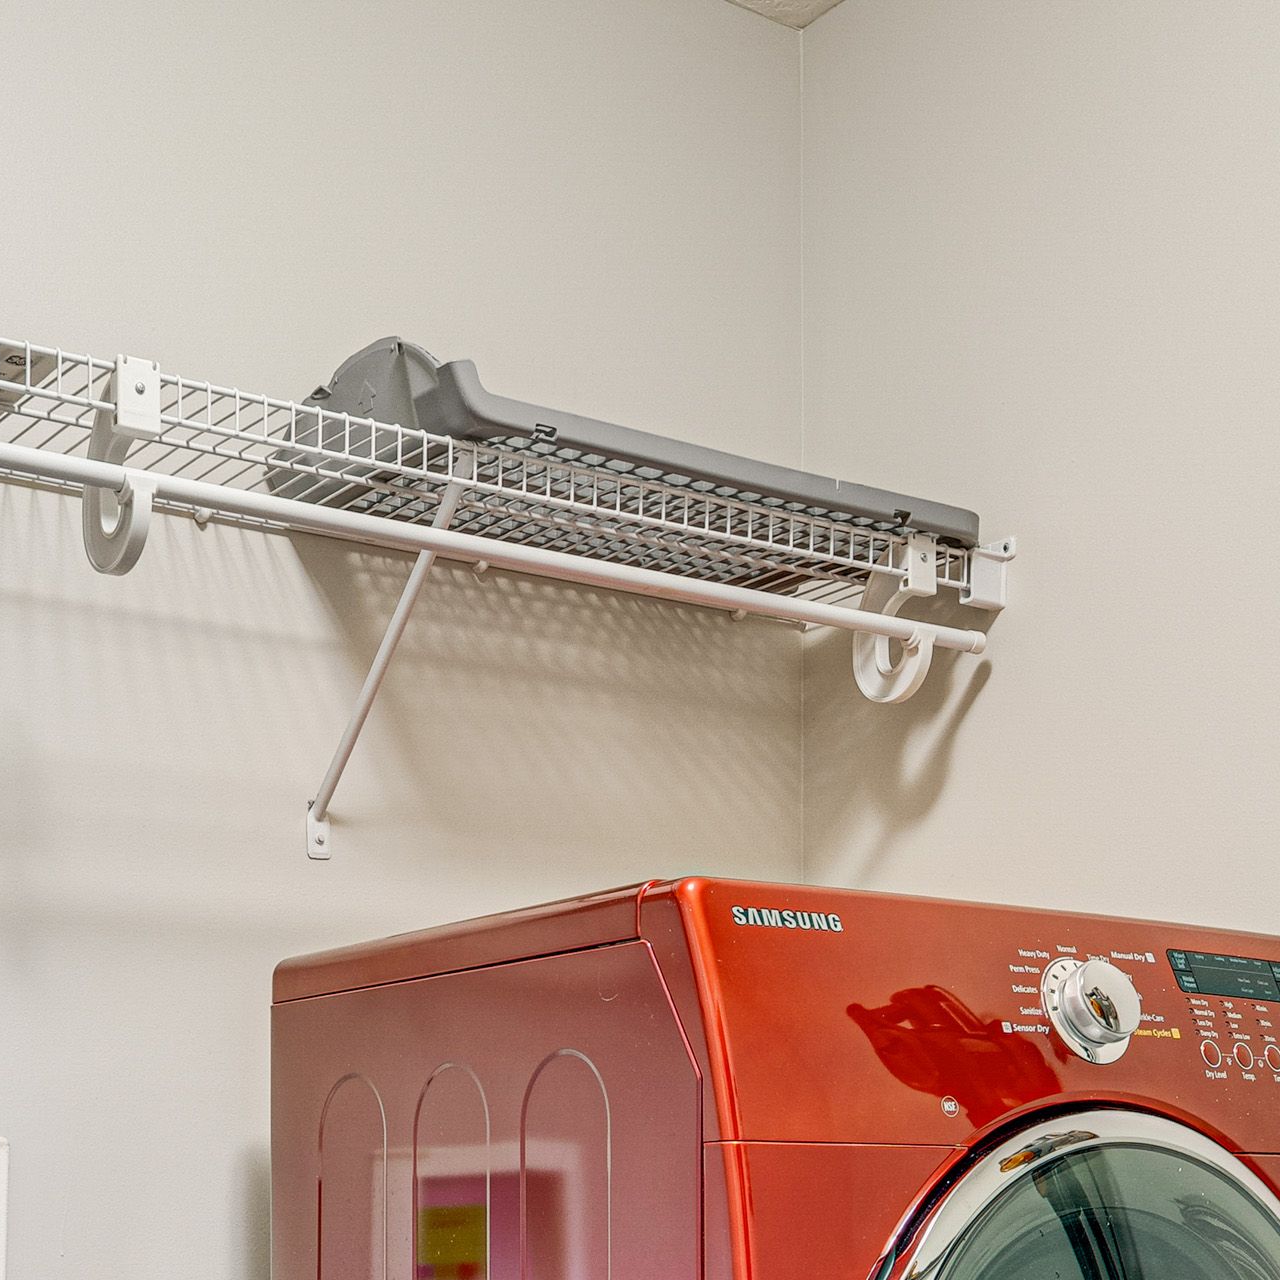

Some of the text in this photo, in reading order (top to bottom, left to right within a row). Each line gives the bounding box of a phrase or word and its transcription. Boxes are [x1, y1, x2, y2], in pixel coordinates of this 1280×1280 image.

[731, 905, 842, 932] SAMSUNG
[1056, 945, 1077, 954] Normal
[1110, 951, 1146, 963] Manual Dry
[1011, 985, 1039, 994] Delicates
[1012, 1023, 1050, 1035] Sensor Dry
[1152, 1028, 1172, 1038] Cycles
[1205, 1070, 1228, 1080] Dry Level
